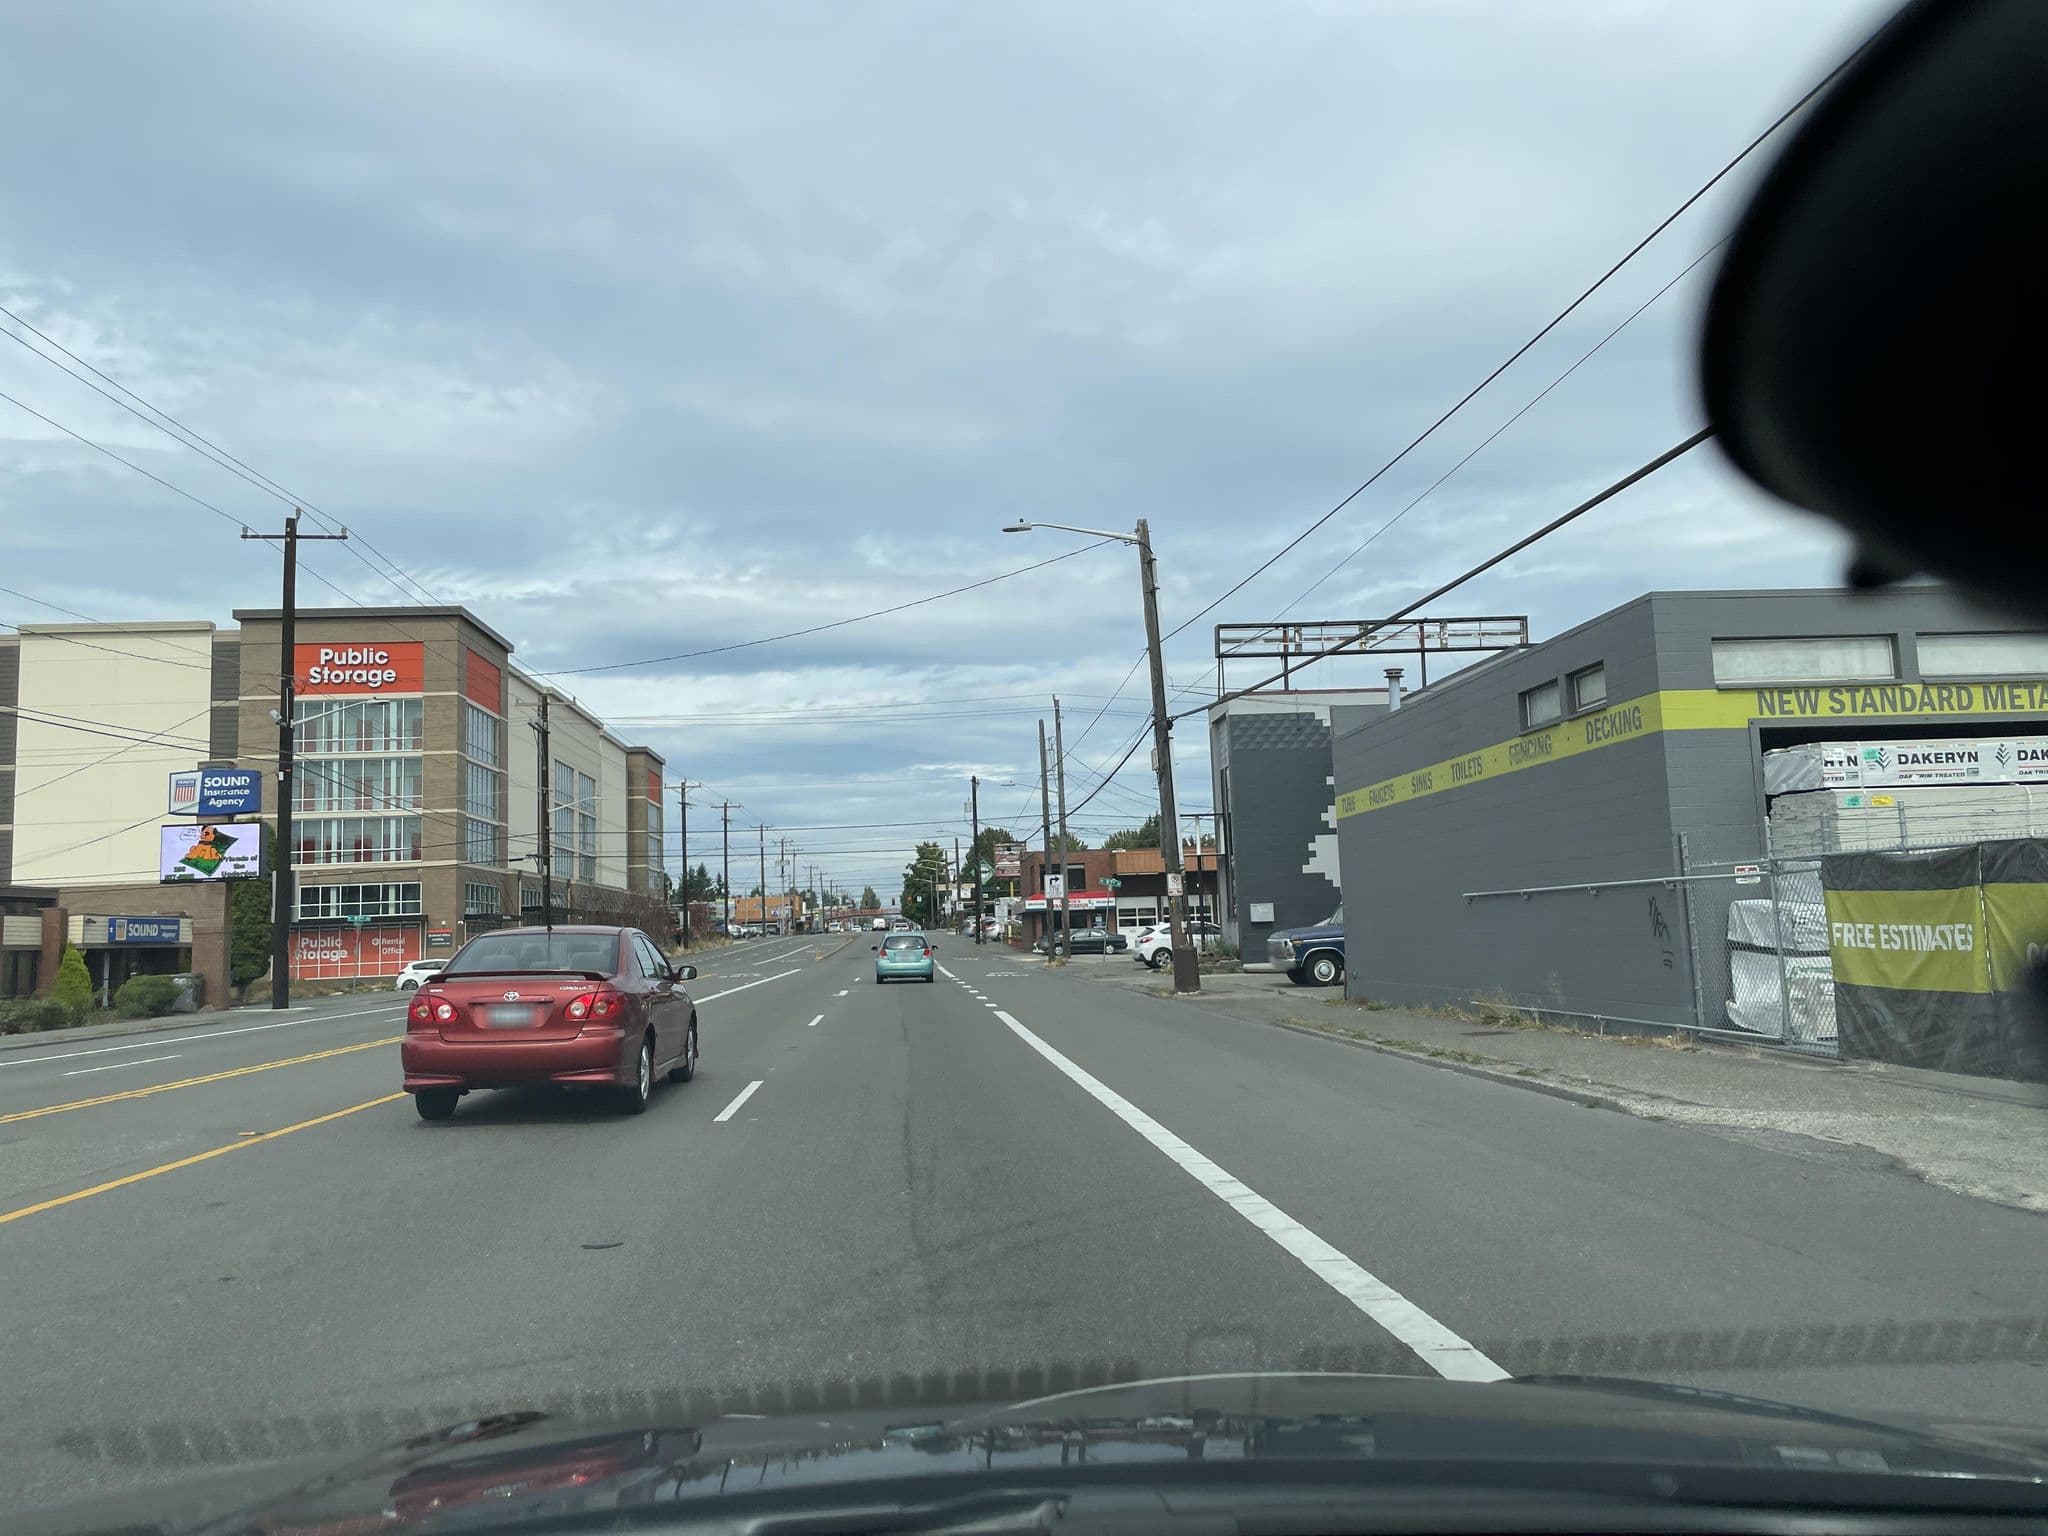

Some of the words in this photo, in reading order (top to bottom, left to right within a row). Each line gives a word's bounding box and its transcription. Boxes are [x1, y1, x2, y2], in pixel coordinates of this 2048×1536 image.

[320, 648, 389, 665] Public
[309, 666, 396, 688] Storage
[1757, 689, 1820, 716] NEW
[1828, 686, 1974, 714] STANDARD
[1369, 784, 1395, 808] FAUCETS
[1411, 771, 1433, 794] SINKS
[1451, 756, 1483, 783] TOILETS
[1585, 705, 1642, 744] DECKING
[1898, 751, 1979, 765] DAKERYN
[204, 776, 250, 787] SOUND
[204, 788, 250, 797] Insurance
[209, 797, 245, 807] Agency
[128, 924, 158, 936] SOUND
[301, 936, 344, 948] Public
[381, 937, 406, 945] Rental
[1832, 922, 1876, 948] FREE
[1879, 923, 1973, 951] ESTIMATES
[382, 947, 405, 955] Office
